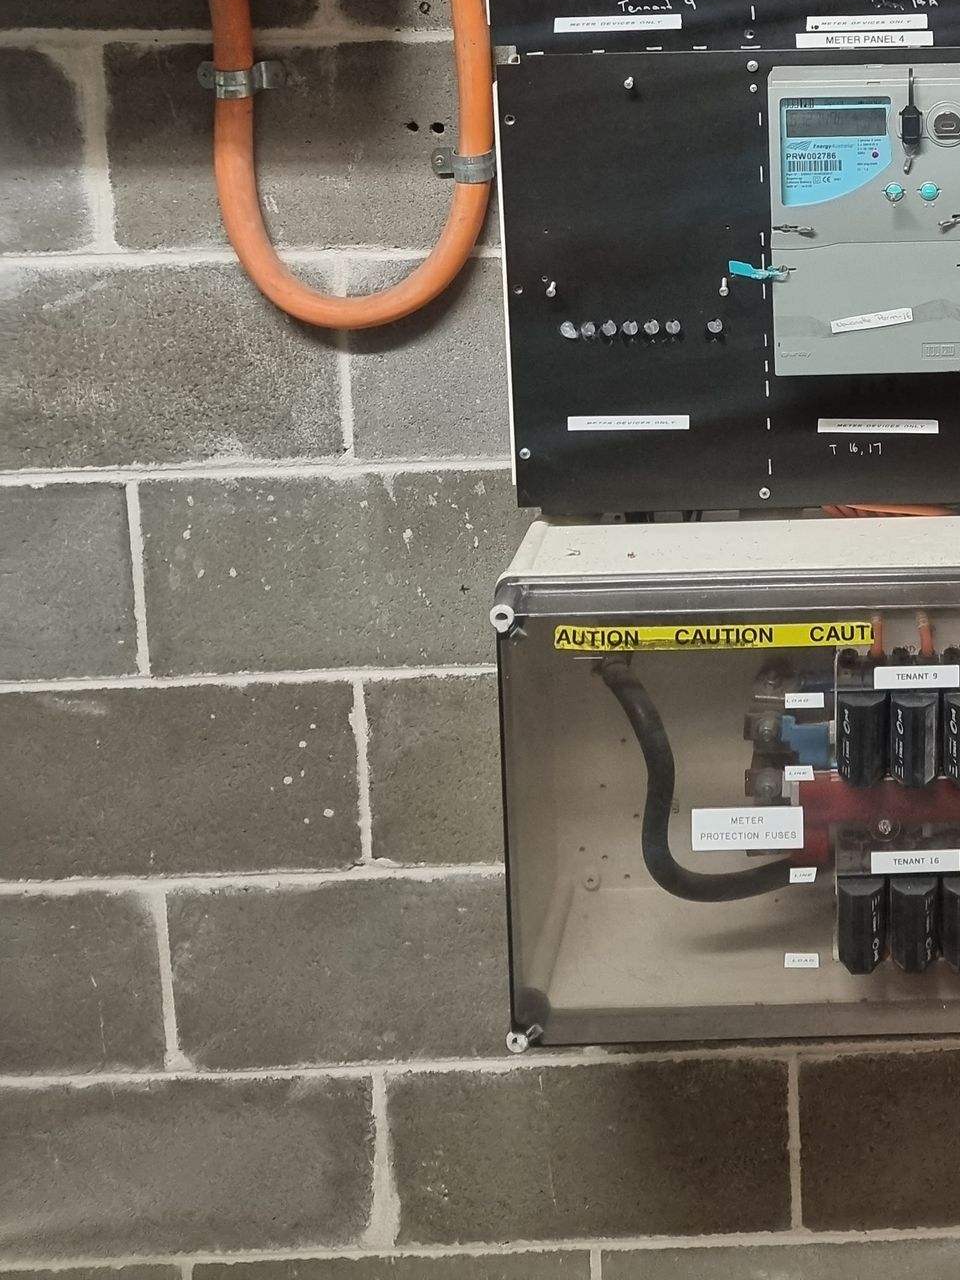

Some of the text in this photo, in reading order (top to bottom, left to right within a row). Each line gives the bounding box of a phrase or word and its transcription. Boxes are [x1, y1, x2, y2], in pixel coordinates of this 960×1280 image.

[825, 35, 905, 45] METER PANEL 4
[786, 152, 837, 160] PRW002786
[829, 444, 837, 455] T
[556, 627, 639, 647] AUTION
[674, 626, 774, 645] CAUTION
[896, 672, 938, 681] TENANT 9
[731, 816, 764, 825] METER
[700, 831, 797, 841] PROTECTION FUSES
[893, 857, 940, 866] TENANT 16
